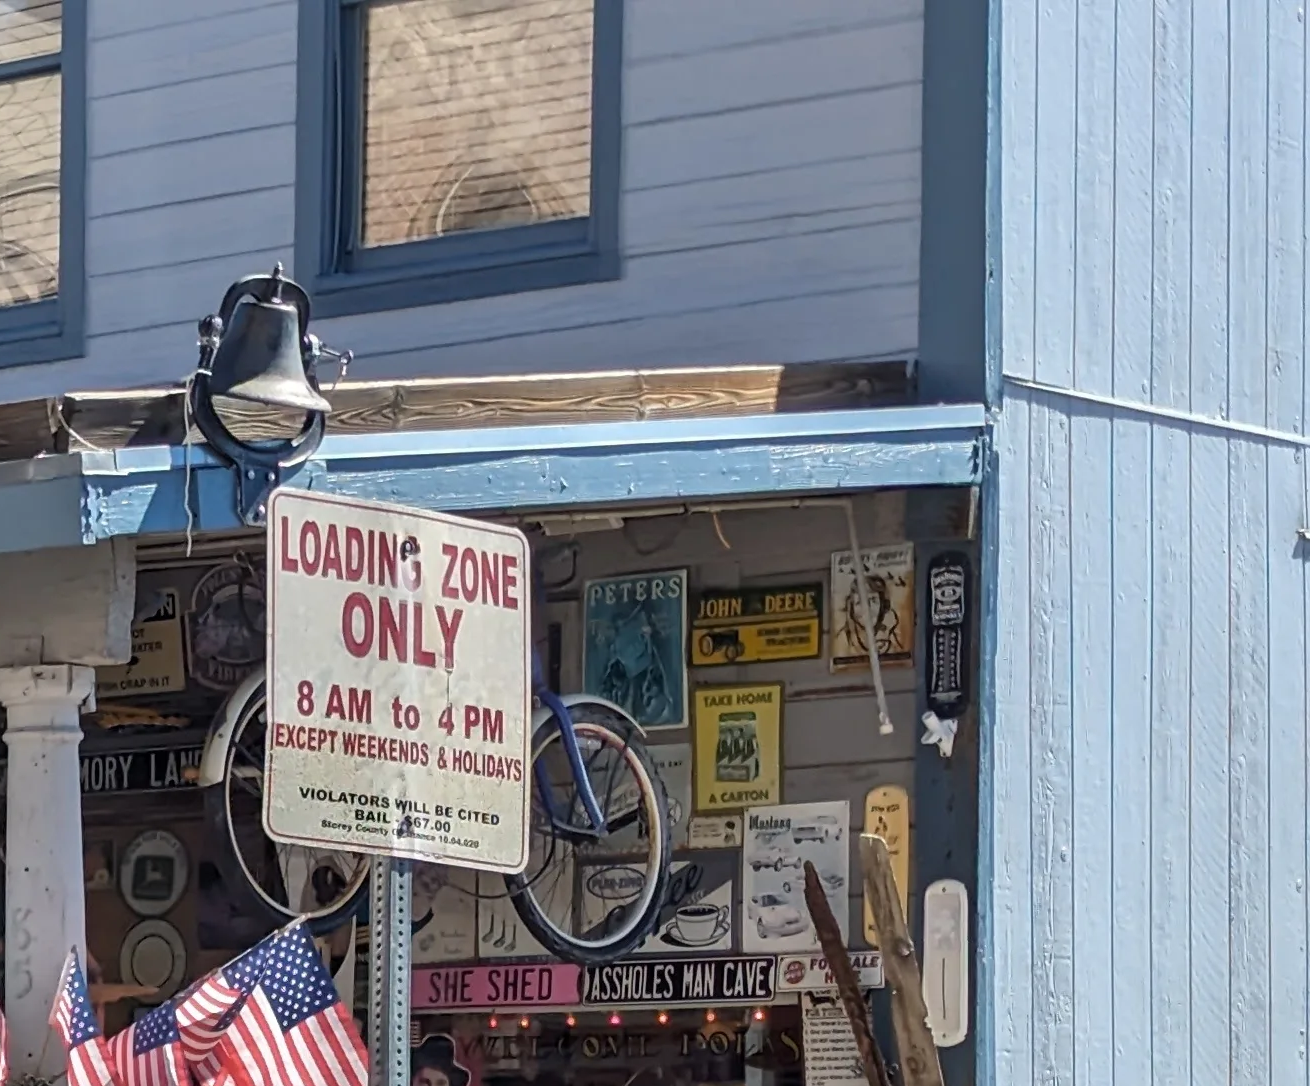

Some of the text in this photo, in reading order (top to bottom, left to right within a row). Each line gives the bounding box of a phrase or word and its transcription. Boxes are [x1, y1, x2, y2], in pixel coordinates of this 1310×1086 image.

[281, 515, 519, 610] LOADING ZONE
[589, 577, 681, 607] PETERS
[697, 591, 815, 620] JOHN DEERE
[341, 592, 463, 669] ONLY
[297, 680, 505, 744] 8 AM to 4 PM
[703, 691, 773, 708] TAKE HOME
[274, 723, 522, 782] EXCEPT WEEKENDS & HOLIDAYS
[81, 749, 201, 791] MORY LAN
[299, 787, 500, 826] VIOLATORS WILL BE CITED
[709, 789, 769, 804] A CARTON
[321, 819, 353, 832] Storey
[355, 823, 389, 836] County
[355, 809, 391, 824] BAIL
[749, 815, 791, 831] Mustang
[851, 955, 880, 968] ALE
[427, 968, 553, 1004] SHE SHED
[589, 960, 769, 1001] ASSHOLES MAN CAVE
